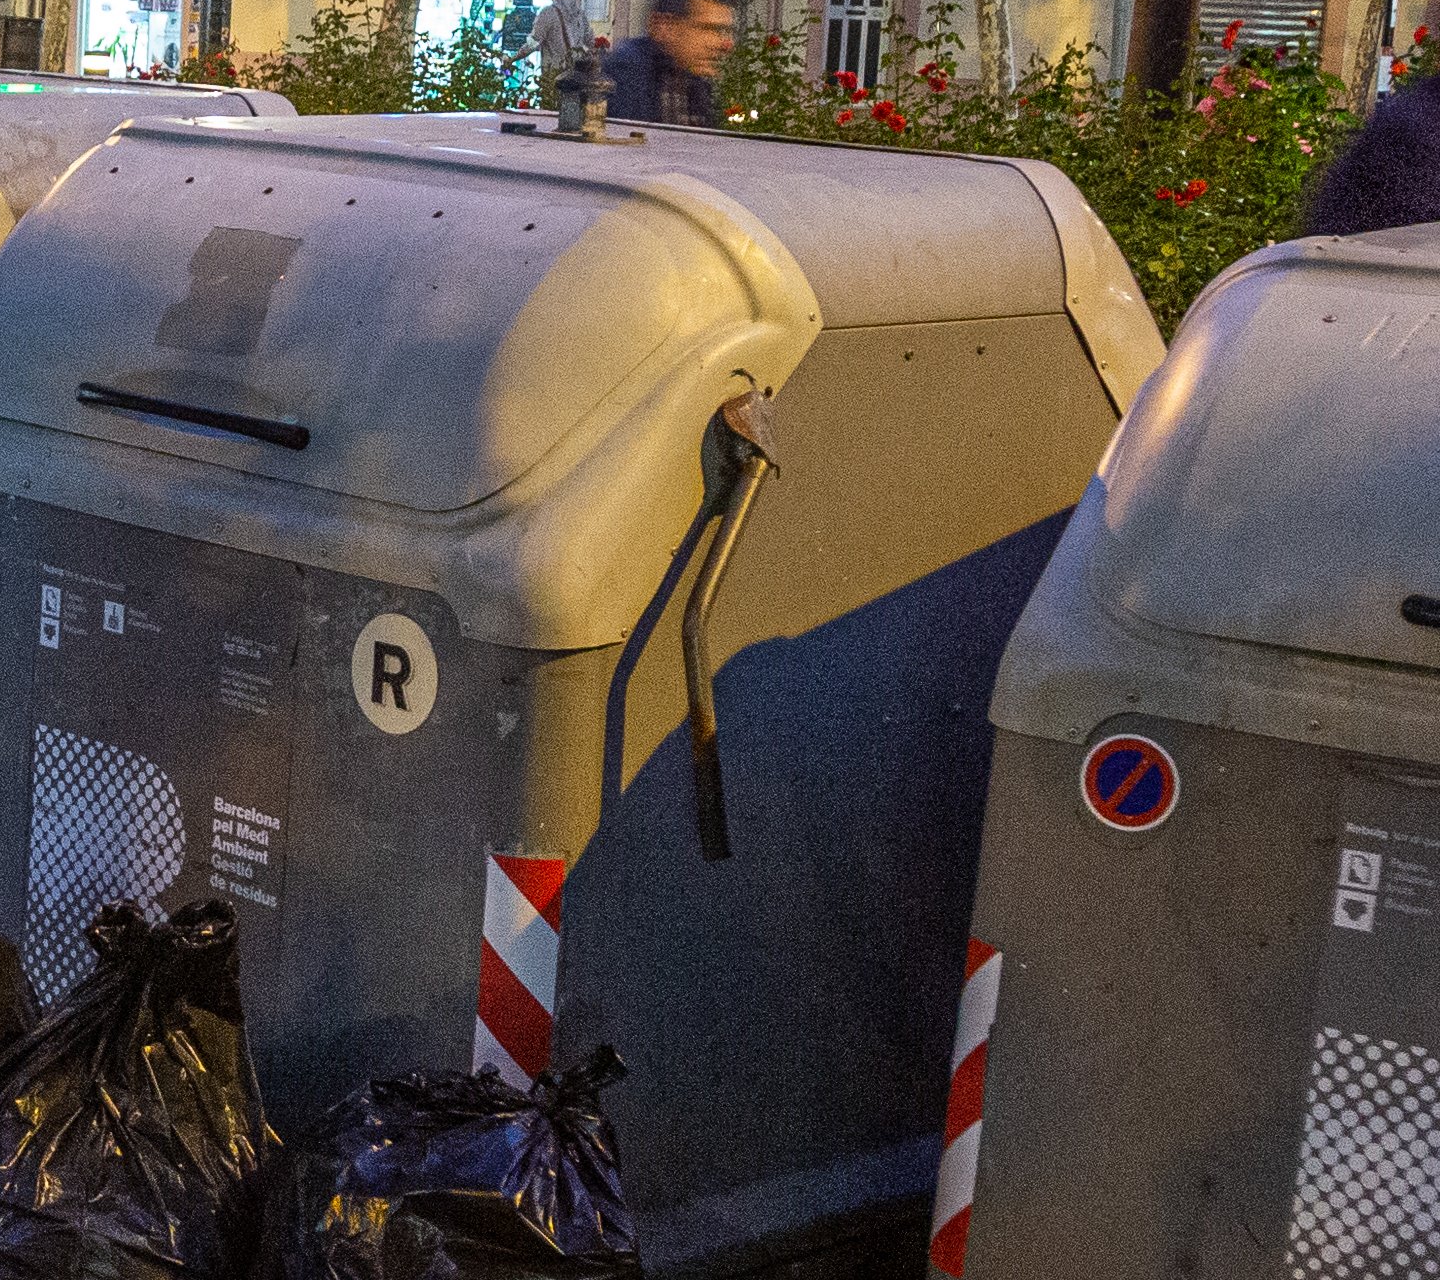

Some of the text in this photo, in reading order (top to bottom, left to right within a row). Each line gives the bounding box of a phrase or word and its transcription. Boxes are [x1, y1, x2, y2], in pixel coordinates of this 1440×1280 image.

[370, 636, 412, 710] R
[214, 796, 281, 831] Barcelona
[212, 818, 270, 846] pel Medi
[212, 835, 269, 866] Ambient
[209, 873, 278, 909] de residus
